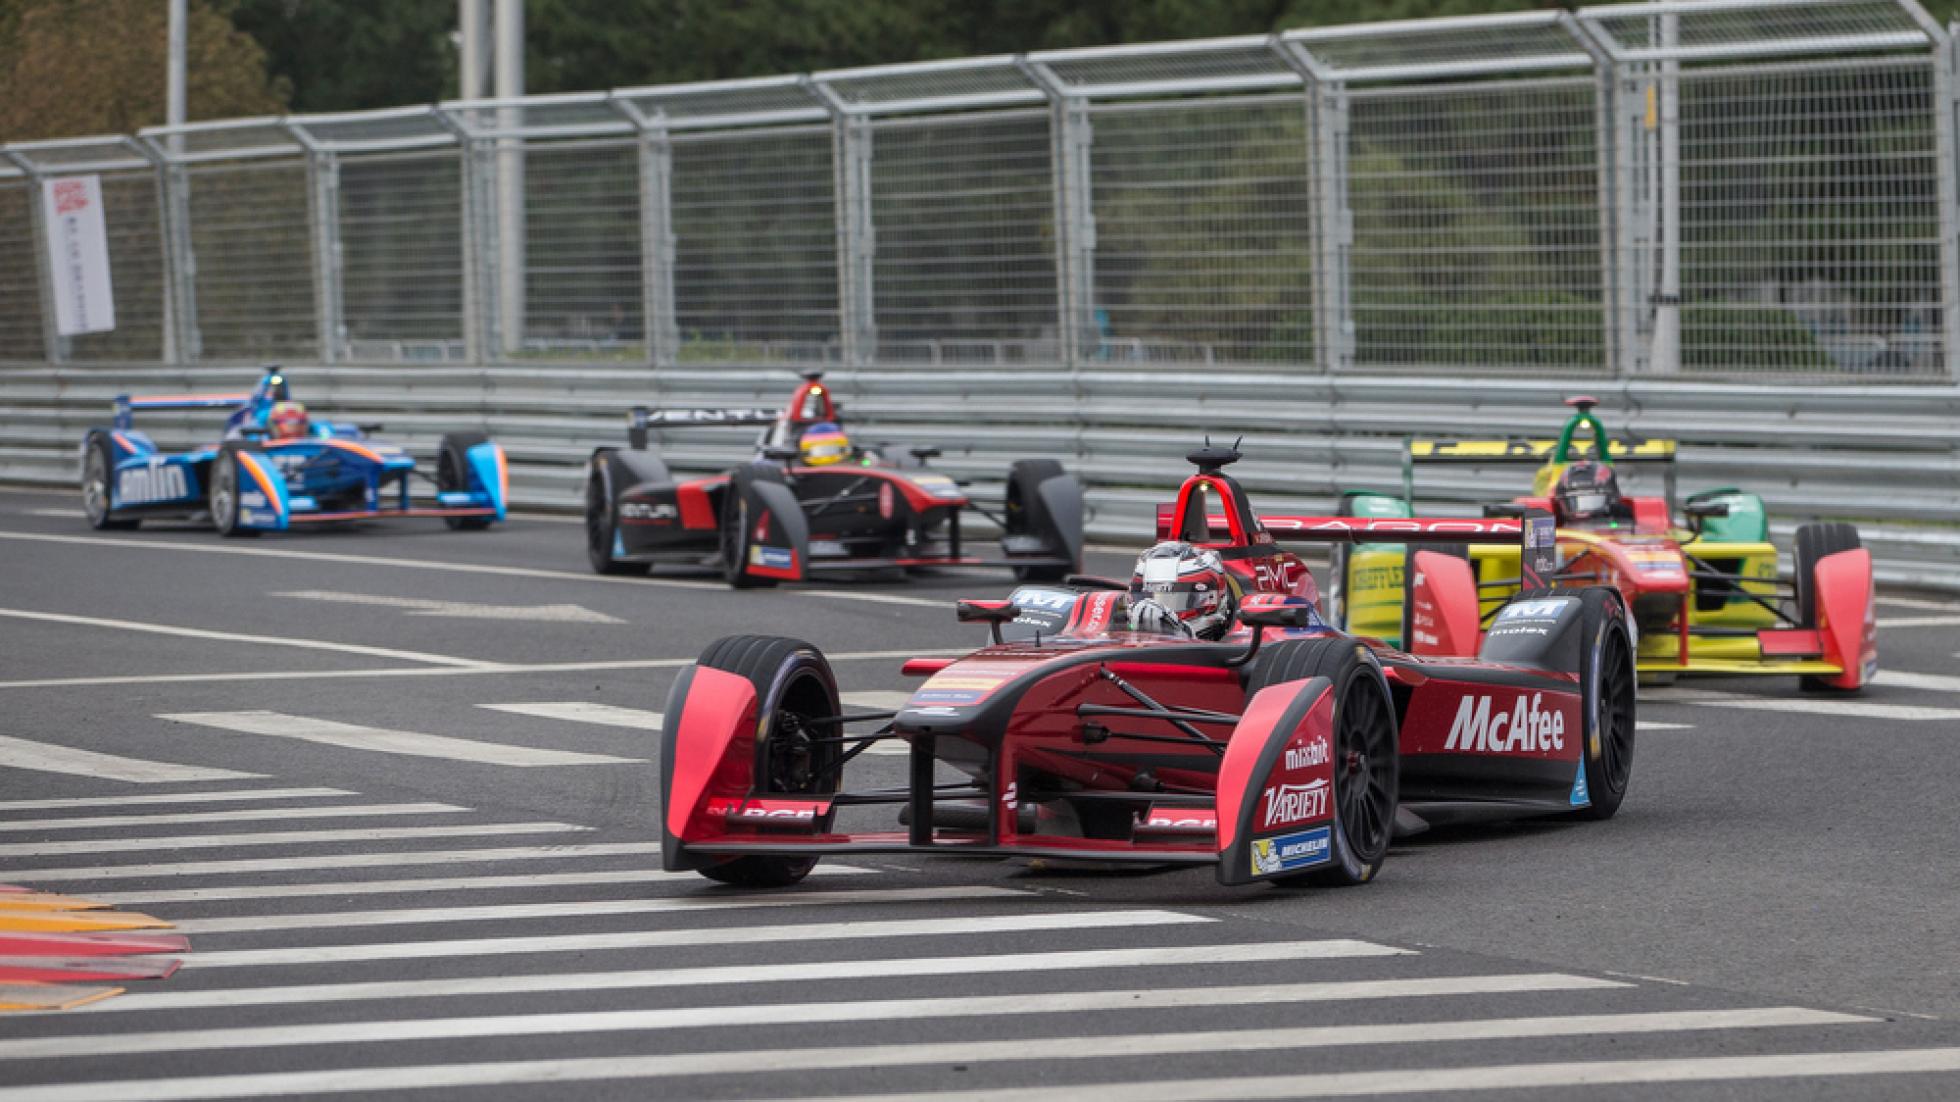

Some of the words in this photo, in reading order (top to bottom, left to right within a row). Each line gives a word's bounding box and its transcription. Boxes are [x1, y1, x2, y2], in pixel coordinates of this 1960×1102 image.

[120, 455, 188, 502] amlin
[1254, 562, 1299, 591] PMC
[1012, 617, 1052, 628] olex
[1444, 692, 1565, 752] McAfee
[1285, 735, 1330, 771] mixbit
[1281, 838, 1329, 857] MICHELIN
